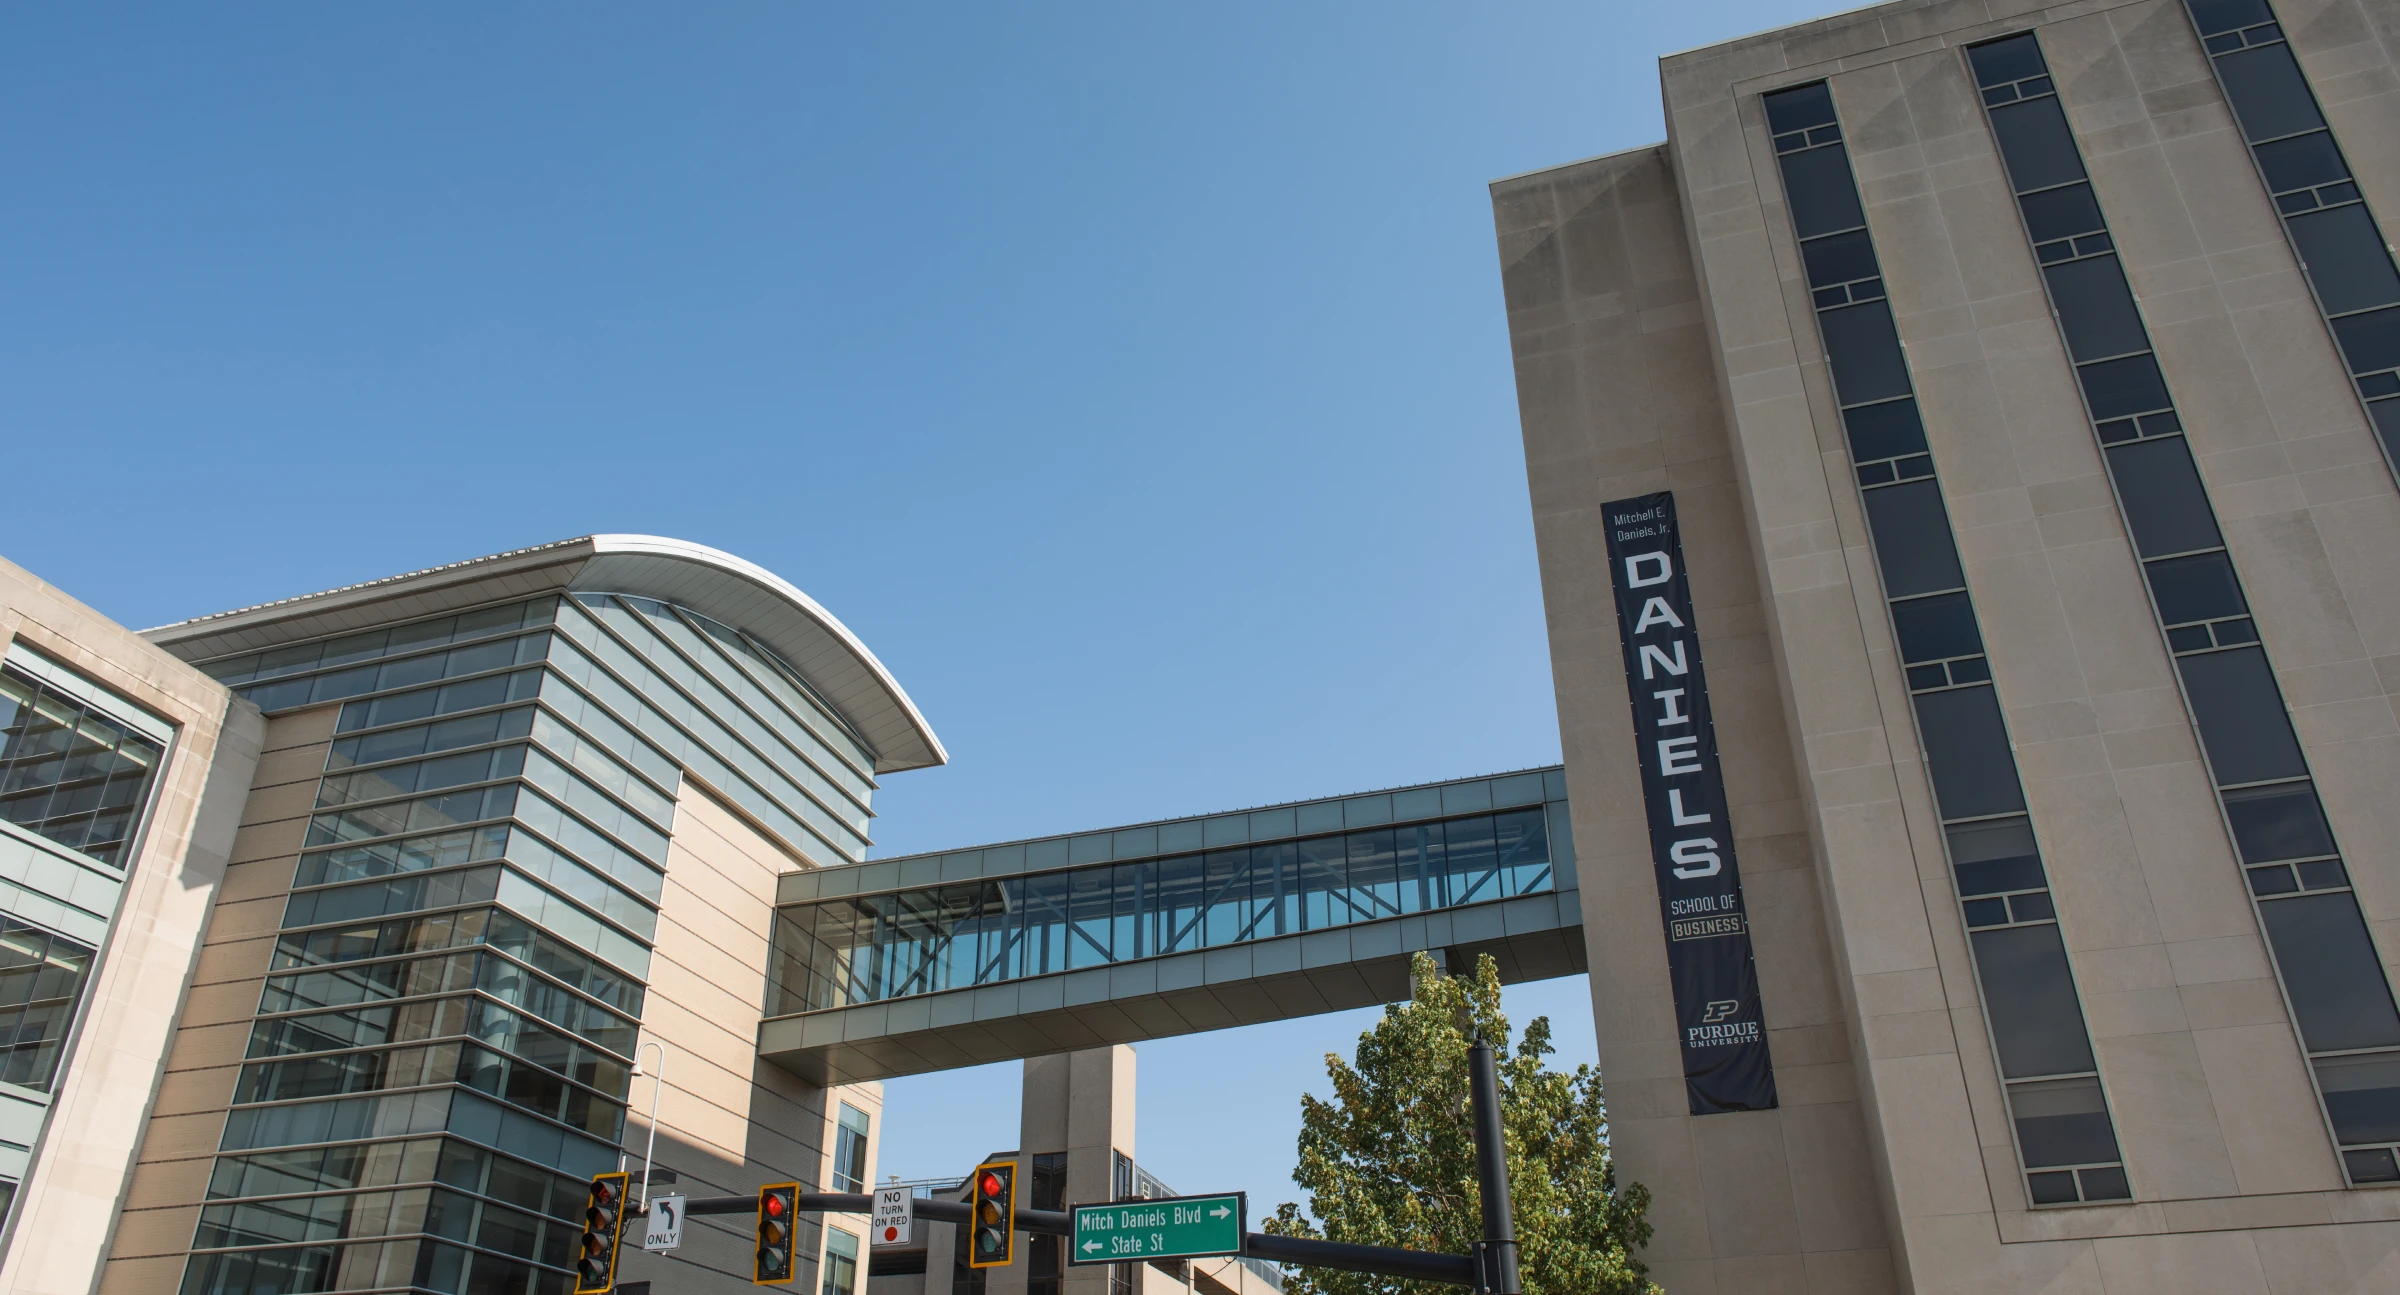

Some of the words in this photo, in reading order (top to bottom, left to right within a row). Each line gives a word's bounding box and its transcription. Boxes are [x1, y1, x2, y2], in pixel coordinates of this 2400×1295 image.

[1614, 508, 1654, 526] Mitchell
[1656, 506, 1666, 518] E.
[1617, 526, 1657, 542] Daniels,
[1659, 523, 1671, 534] Jr.
[1625, 550, 1721, 880] DANIELS
[1671, 896, 1719, 915] SCHOOL
[1720, 894, 1736, 909] OF
[1674, 917, 1739, 937] BUSINESS
[1702, 999, 1739, 1023] P
[1688, 1021, 1759, 1041] PURDUE
[1690, 1034, 1759, 1048] UNIVERSITY
[884, 1191, 901, 1203] NO
[881, 1204, 904, 1215] TURN
[1081, 1213, 1114, 1231] Mitch
[1121, 1209, 1166, 1229] Daniels
[1174, 1206, 1201, 1225] Blvd
[875, 1218, 888, 1227] ON
[890, 1215, 908, 1226] RED
[647, 1233, 677, 1245] ONLY
[1111, 1236, 1142, 1254] State
[1151, 1233, 1164, 1251] St
